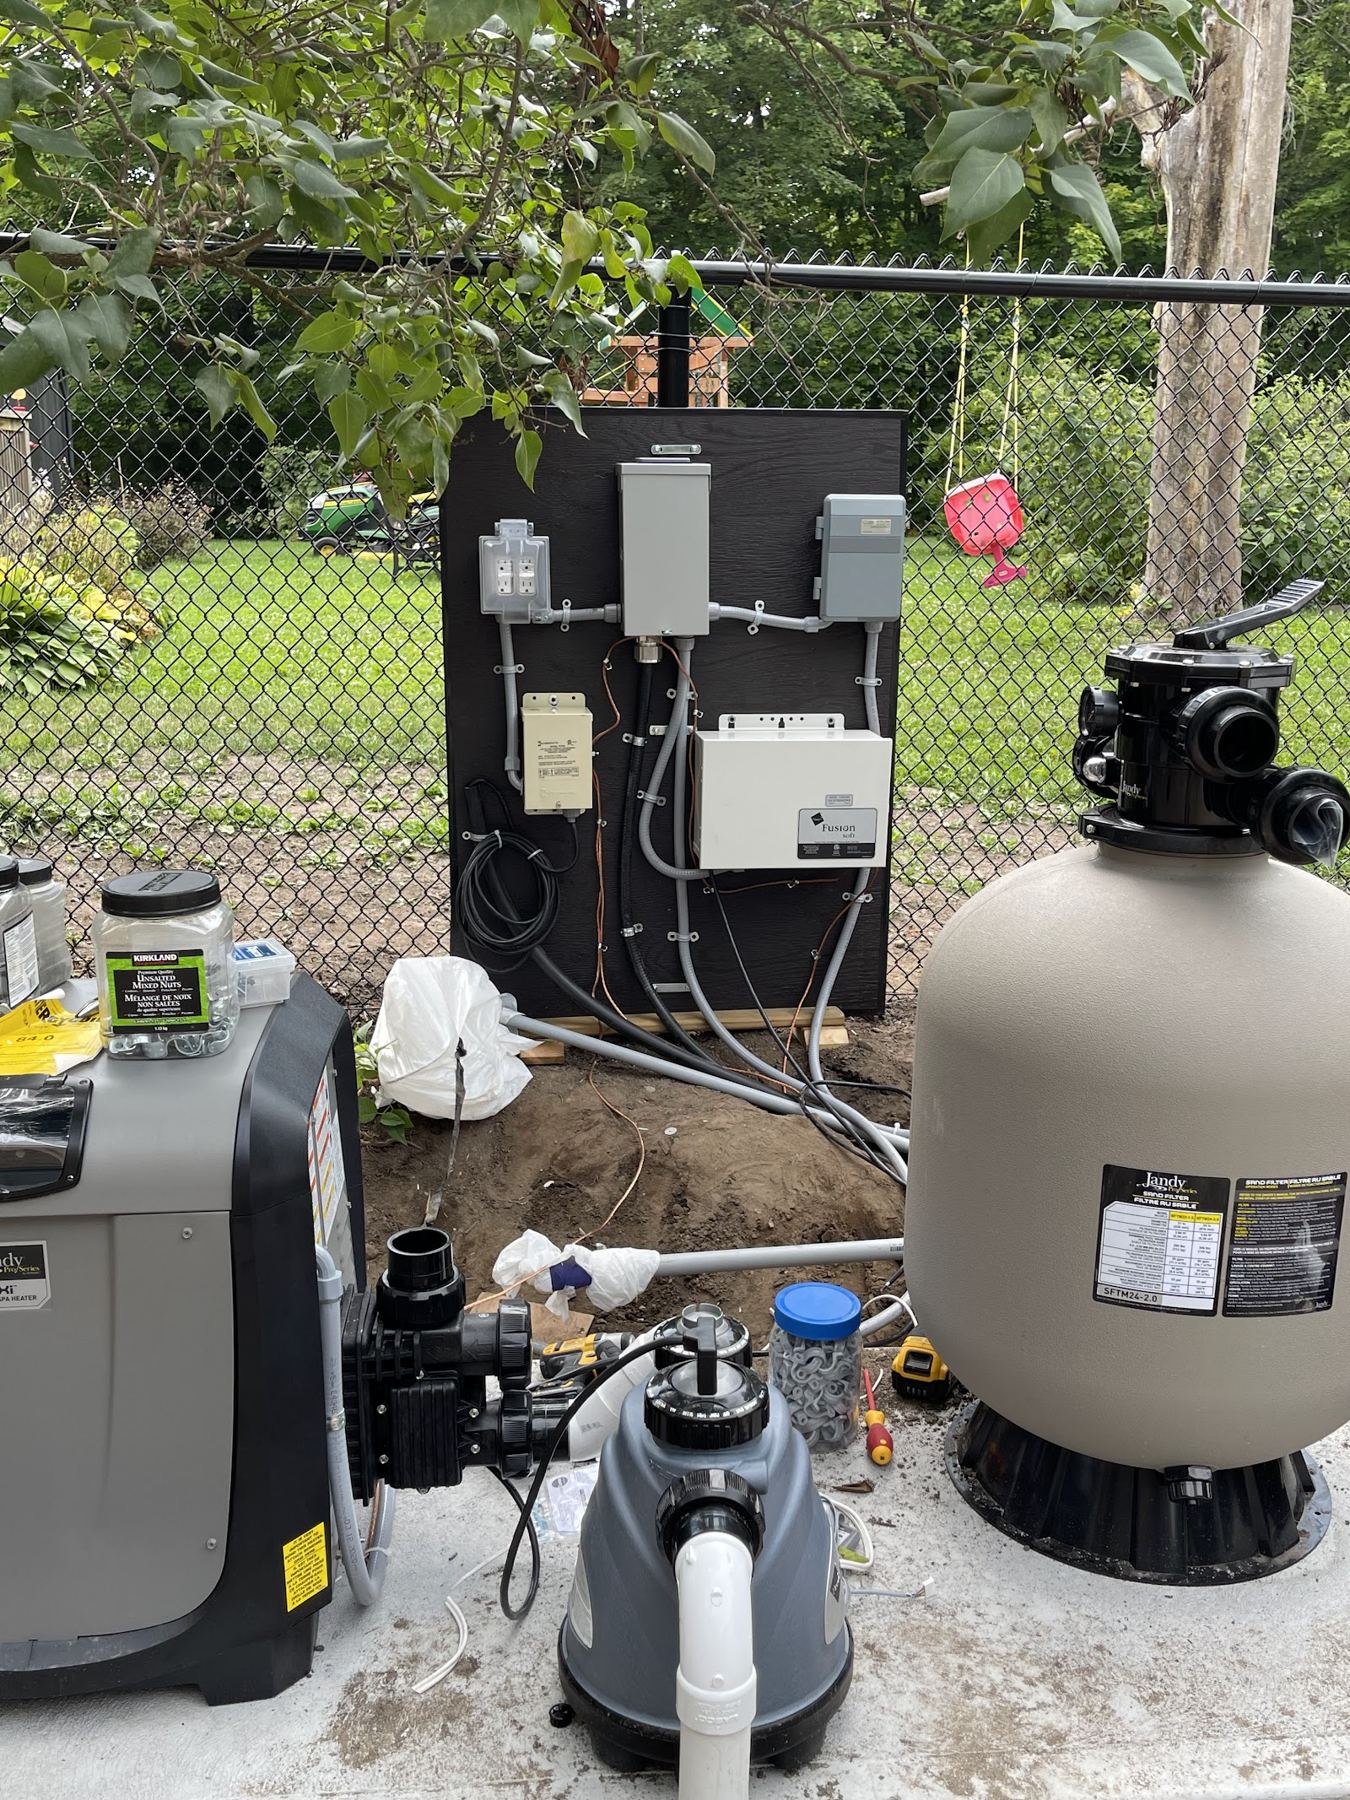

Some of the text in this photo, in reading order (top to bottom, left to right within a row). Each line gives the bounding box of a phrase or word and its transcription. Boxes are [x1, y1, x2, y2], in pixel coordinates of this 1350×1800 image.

[822, 823, 856, 832] Fusion
[133, 954, 177, 962] KIRKLAND
[1141, 1171, 1187, 1188] Jandy
[1143, 1190, 1190, 1201] SAND FILTER
[1103, 1287, 1158, 1303] SFTM24-2.0
